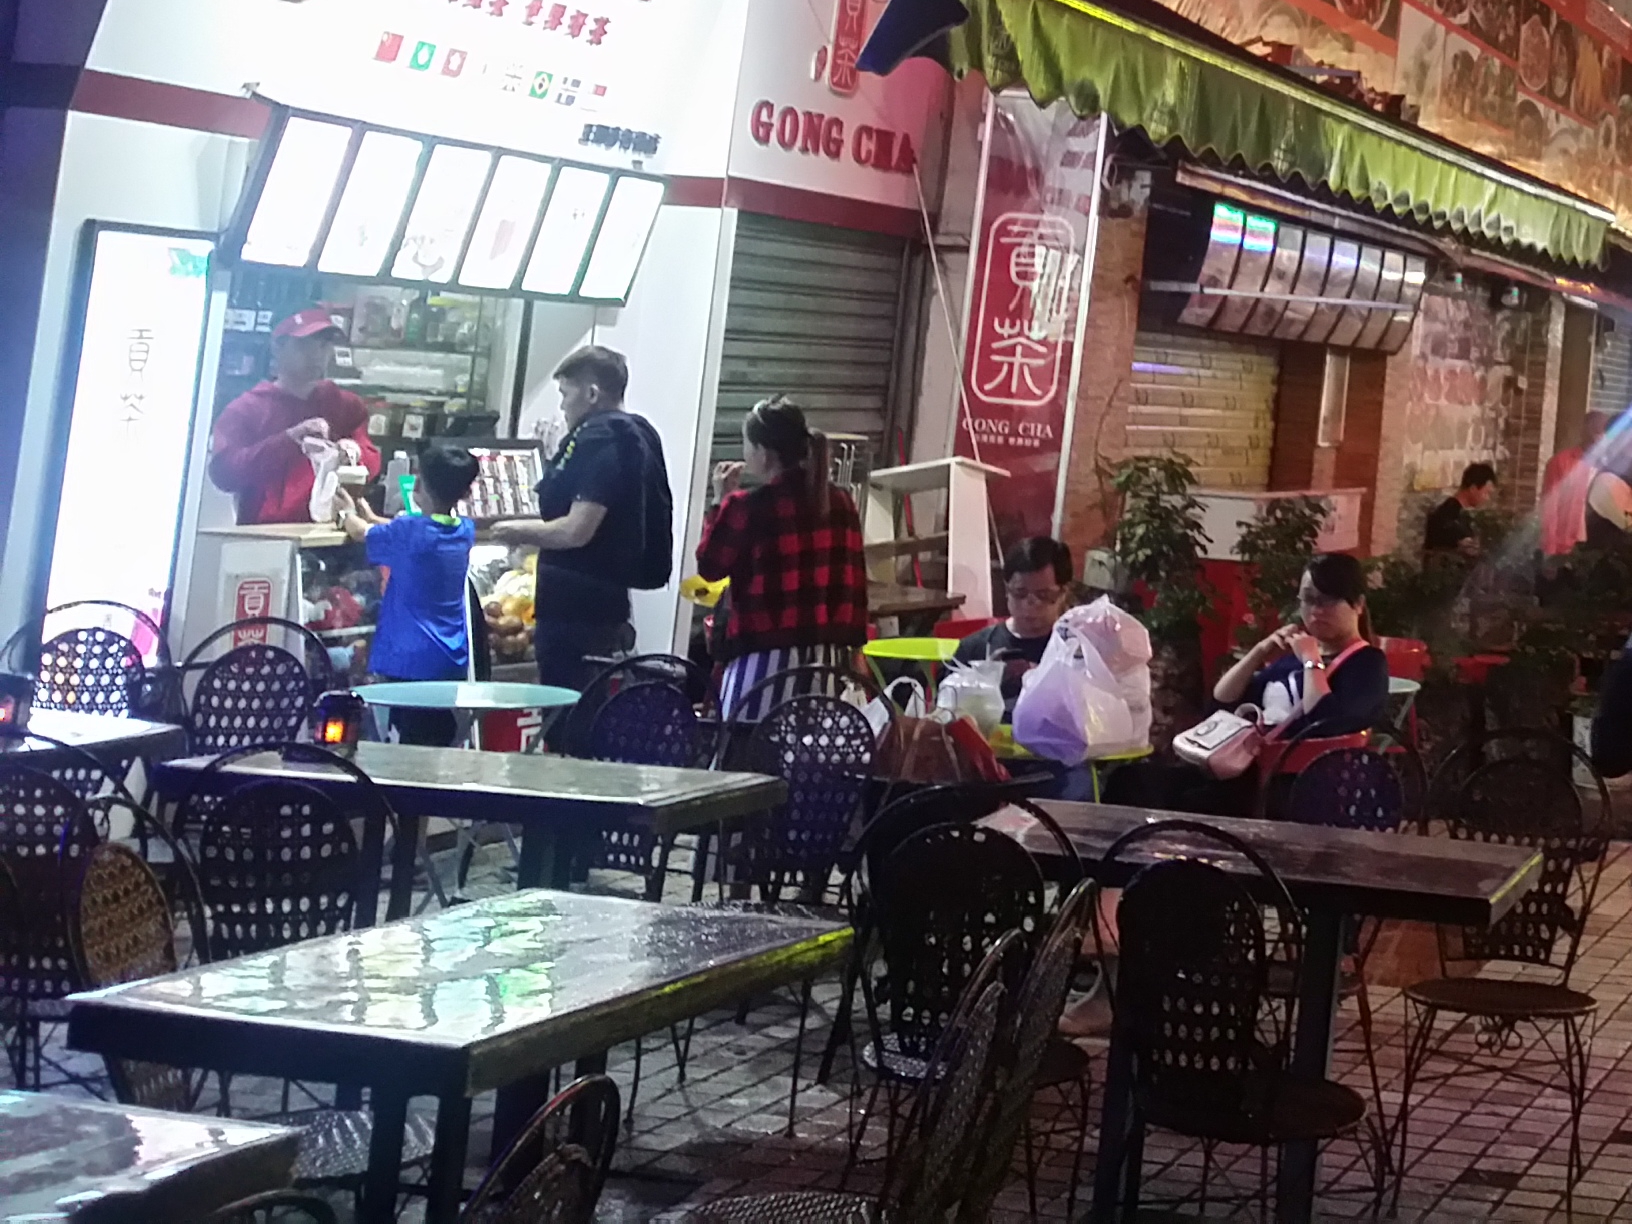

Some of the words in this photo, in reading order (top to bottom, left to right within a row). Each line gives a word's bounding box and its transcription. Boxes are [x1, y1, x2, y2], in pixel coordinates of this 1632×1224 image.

[751, 101, 845, 161] GONG
[852, 125, 914, 172] CHA
[1018, 422, 1053, 439] CHA
